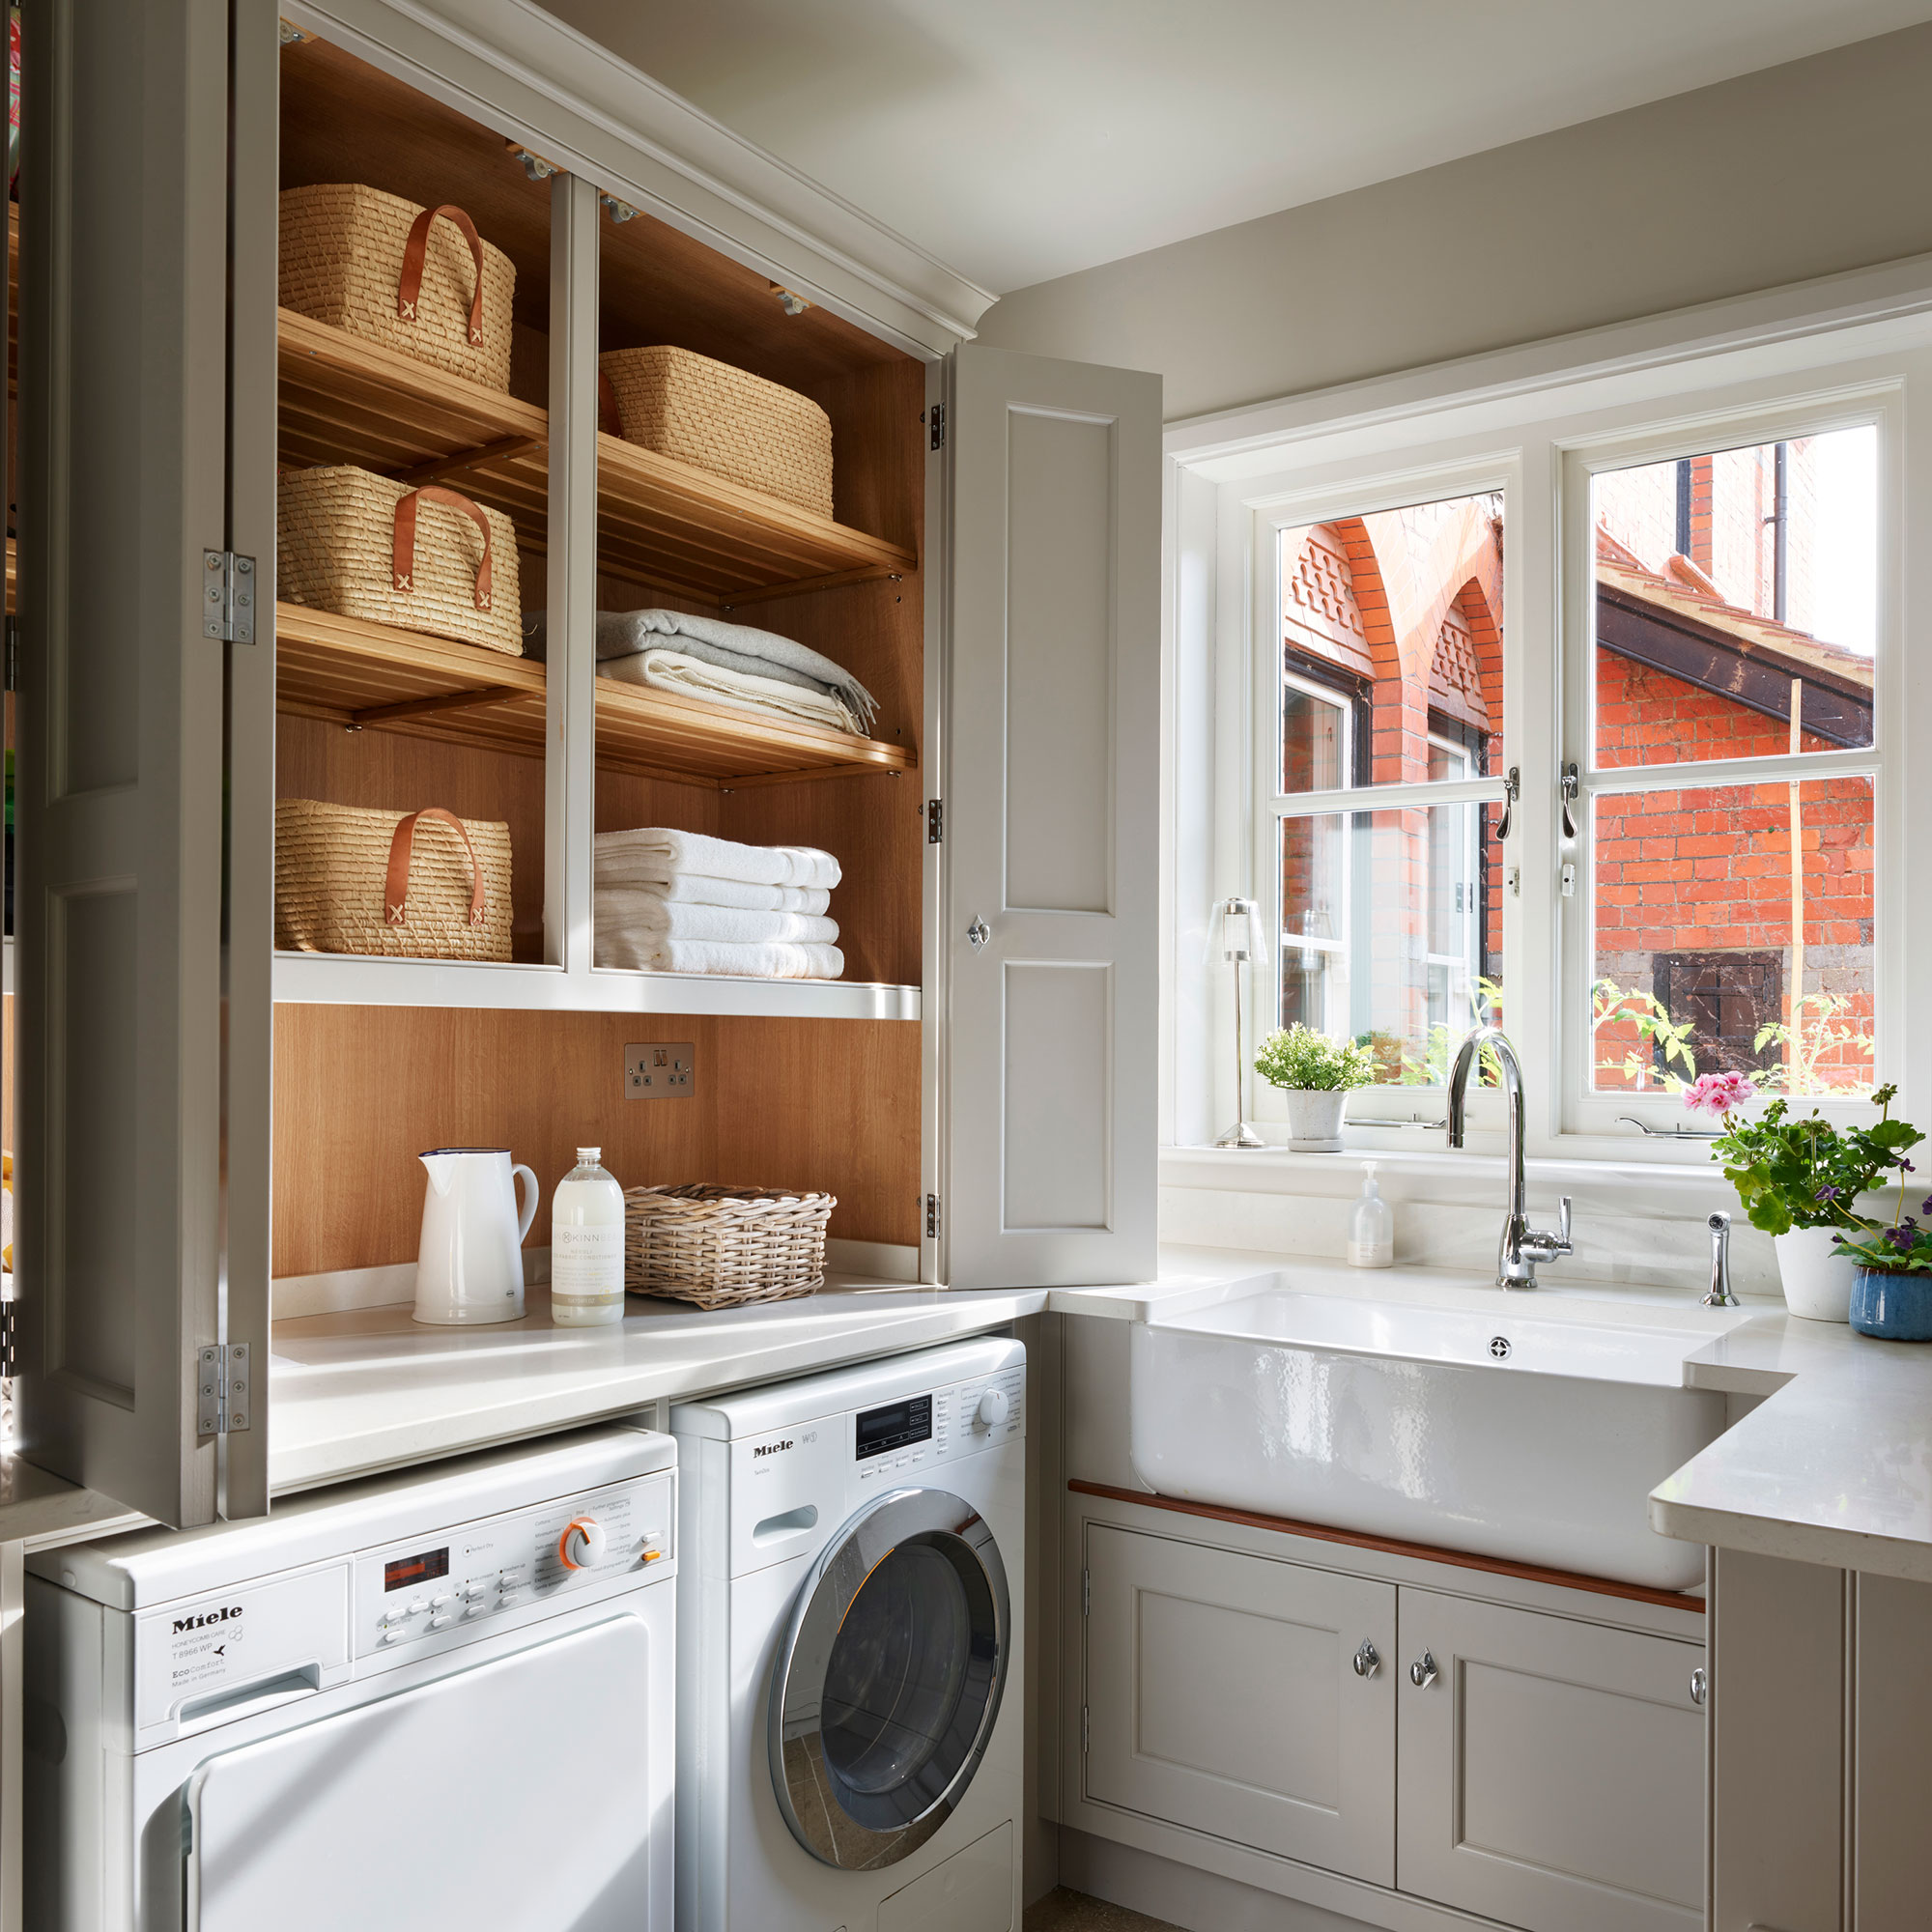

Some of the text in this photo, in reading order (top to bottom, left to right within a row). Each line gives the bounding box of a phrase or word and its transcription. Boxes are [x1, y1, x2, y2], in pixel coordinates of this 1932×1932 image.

[753, 1440, 793, 1459] Miele
[172, 1606, 243, 1634] Miele
[172, 1629, 226, 1649] HONEYCOMB CARE
[179, 1646, 199, 1659] 8966
[199, 1642, 213, 1653] WP
[172, 1659, 225, 1679] EcoComfort
[172, 1678, 189, 1688] Made
[199, 1667, 226, 1679] Germany
